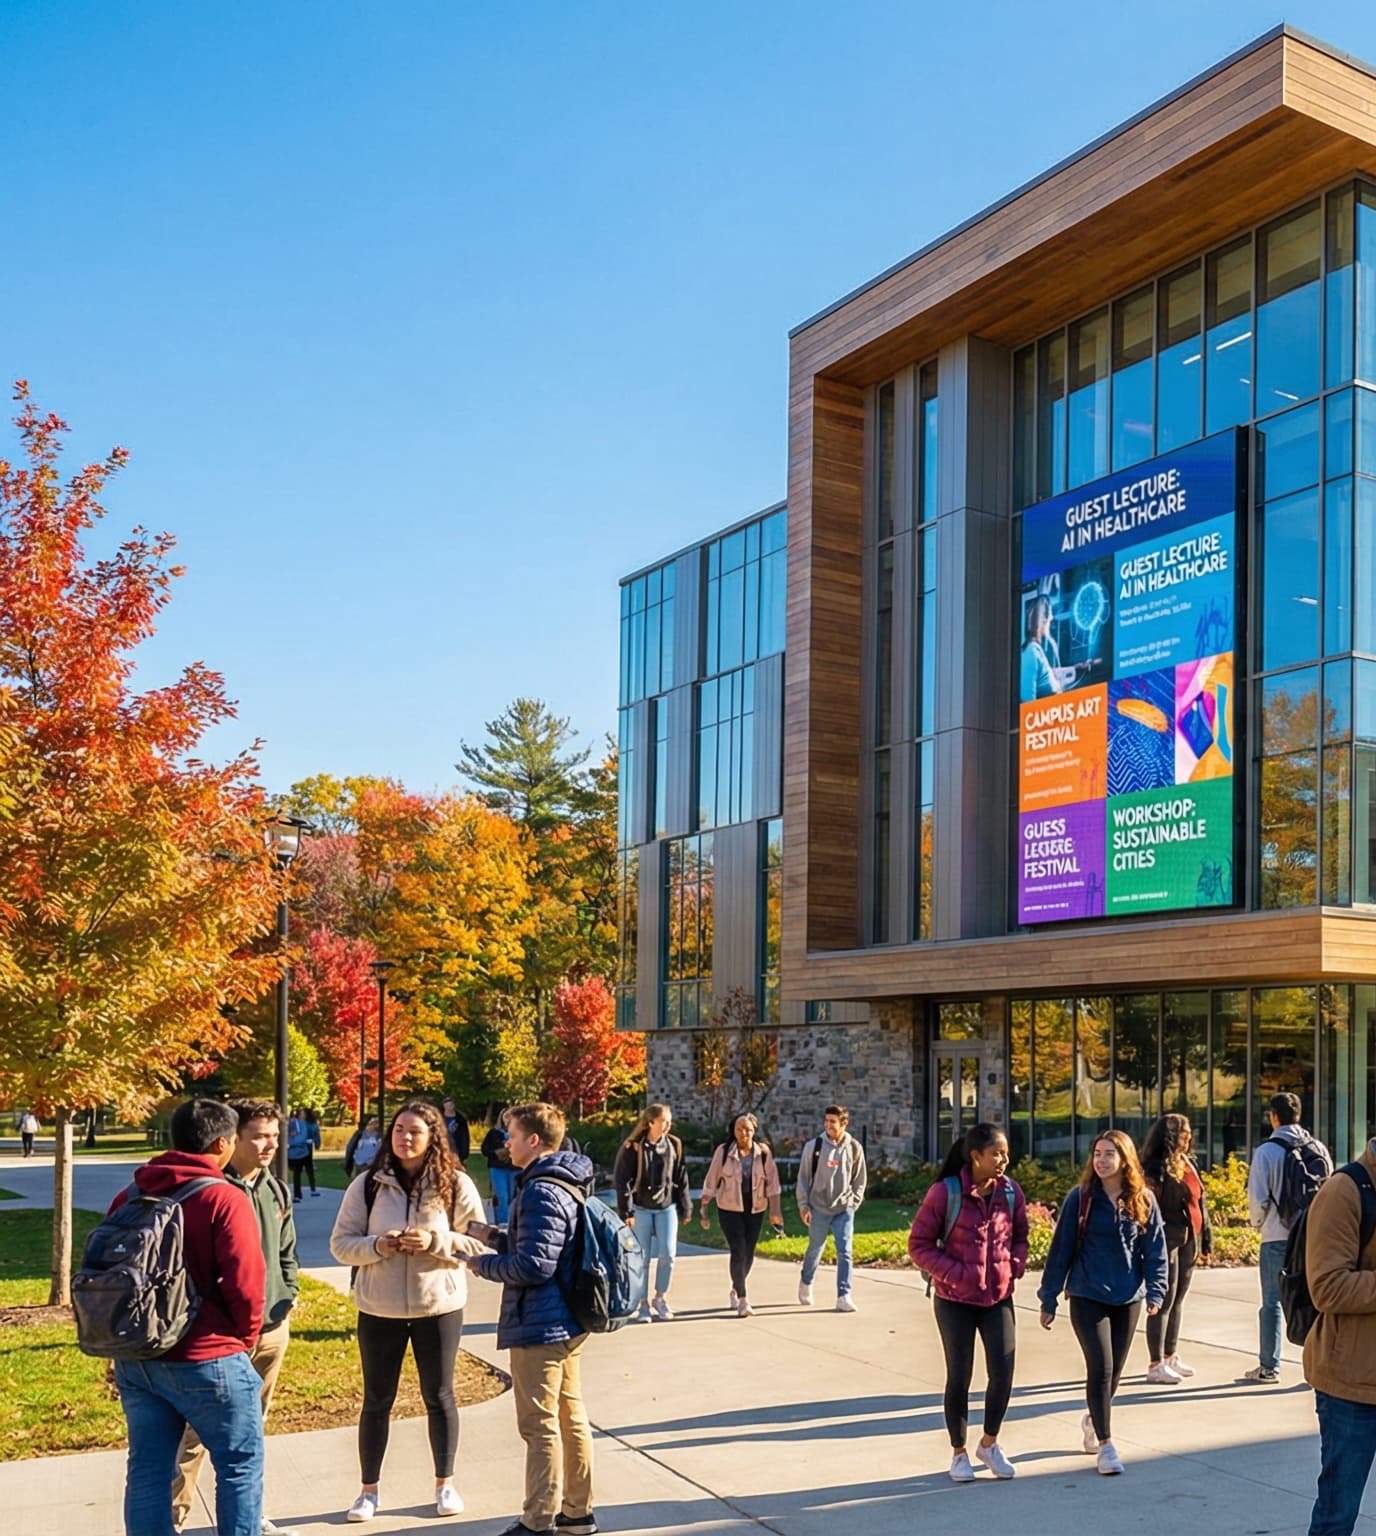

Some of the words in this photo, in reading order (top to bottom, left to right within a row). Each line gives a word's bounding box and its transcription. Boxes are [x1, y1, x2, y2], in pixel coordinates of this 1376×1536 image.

[1066, 494, 1110, 527] GUEST
[1113, 469, 1180, 511] LECTURE:
[1061, 530, 1074, 552] AI
[1078, 524, 1091, 547] IN
[1095, 490, 1186, 541] HEALTHCARE
[1120, 552, 1160, 580] GUEST
[1120, 580, 1131, 600] AI
[1134, 575, 1146, 596] IN
[1149, 550, 1228, 592] HEALTHCARE
[1025, 702, 1075, 731] CAMPUS
[1076, 696, 1102, 719] ART
[1025, 722, 1080, 751] FESTIVAL
[1113, 798, 1196, 828] WORKSHOP:
[1024, 818, 1066, 840] GUESS
[1113, 819, 1206, 850] SUSTAINABLE
[1024, 856, 1080, 879] FESTIVAL
[1113, 849, 1156, 872] CITIES
